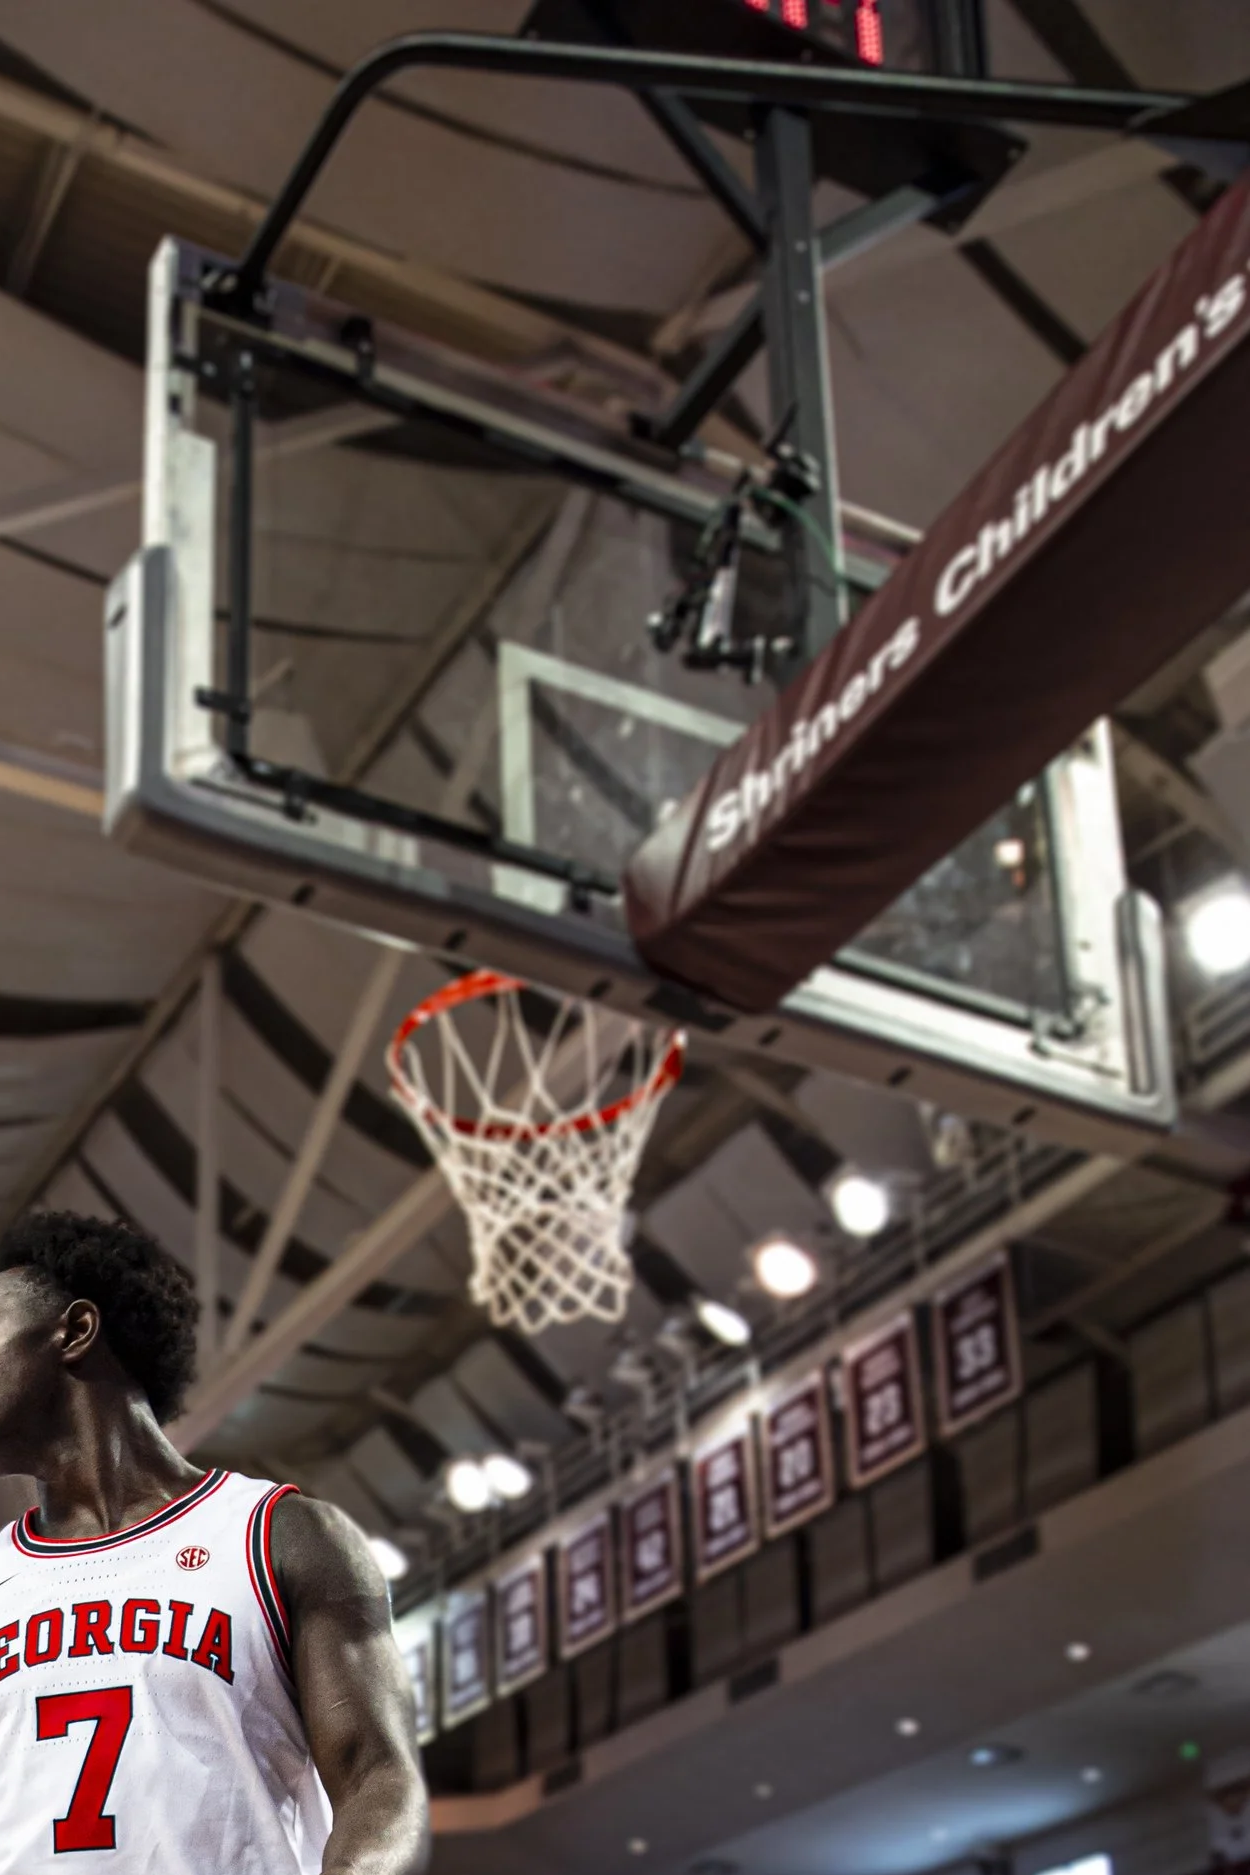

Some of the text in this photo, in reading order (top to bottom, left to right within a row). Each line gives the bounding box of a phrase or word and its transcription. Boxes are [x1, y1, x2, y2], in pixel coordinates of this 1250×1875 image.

[707, 274, 1245, 851] Shriners Children's
[179, 1547, 207, 1568] SEC
[36, 1684, 134, 1854] 7
